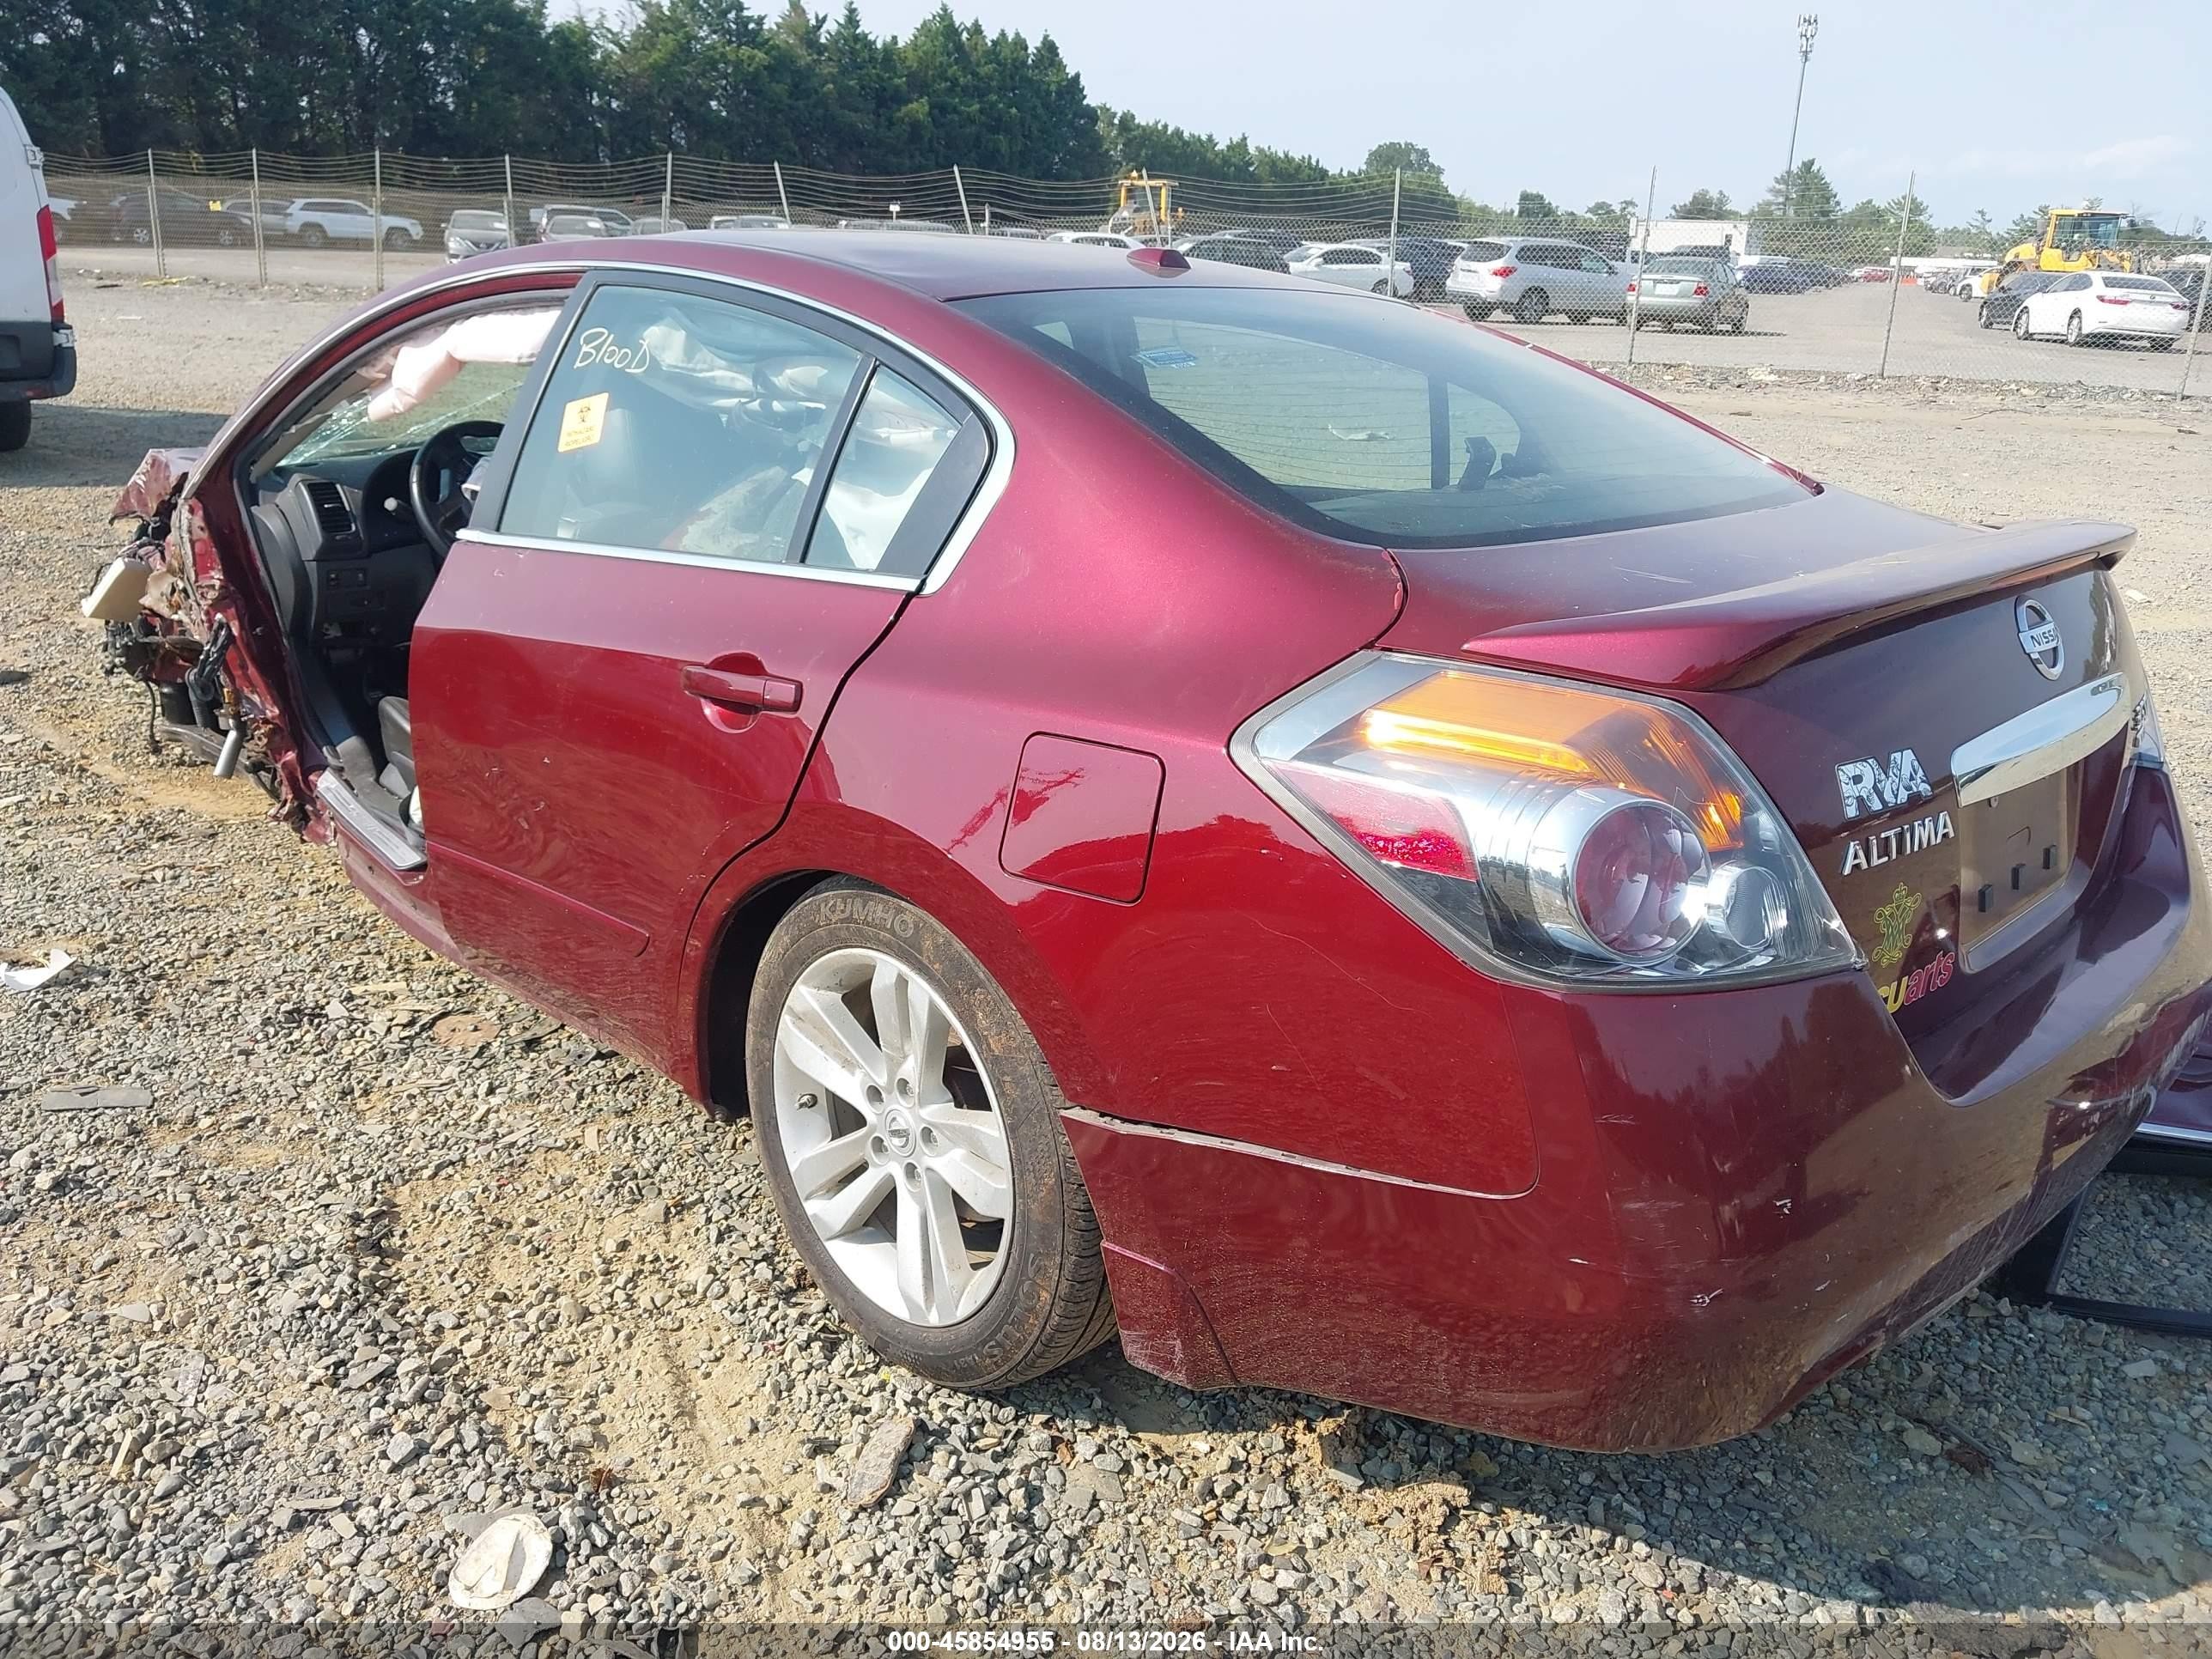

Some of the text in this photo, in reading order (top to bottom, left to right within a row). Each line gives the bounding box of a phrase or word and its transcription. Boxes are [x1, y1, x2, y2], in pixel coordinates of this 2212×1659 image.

[2030, 628, 2057, 648] NISS
[1835, 748, 1934, 819] RVA
[1841, 811, 1955, 876] ALTIMA
[818, 898, 915, 938] KUMHO
